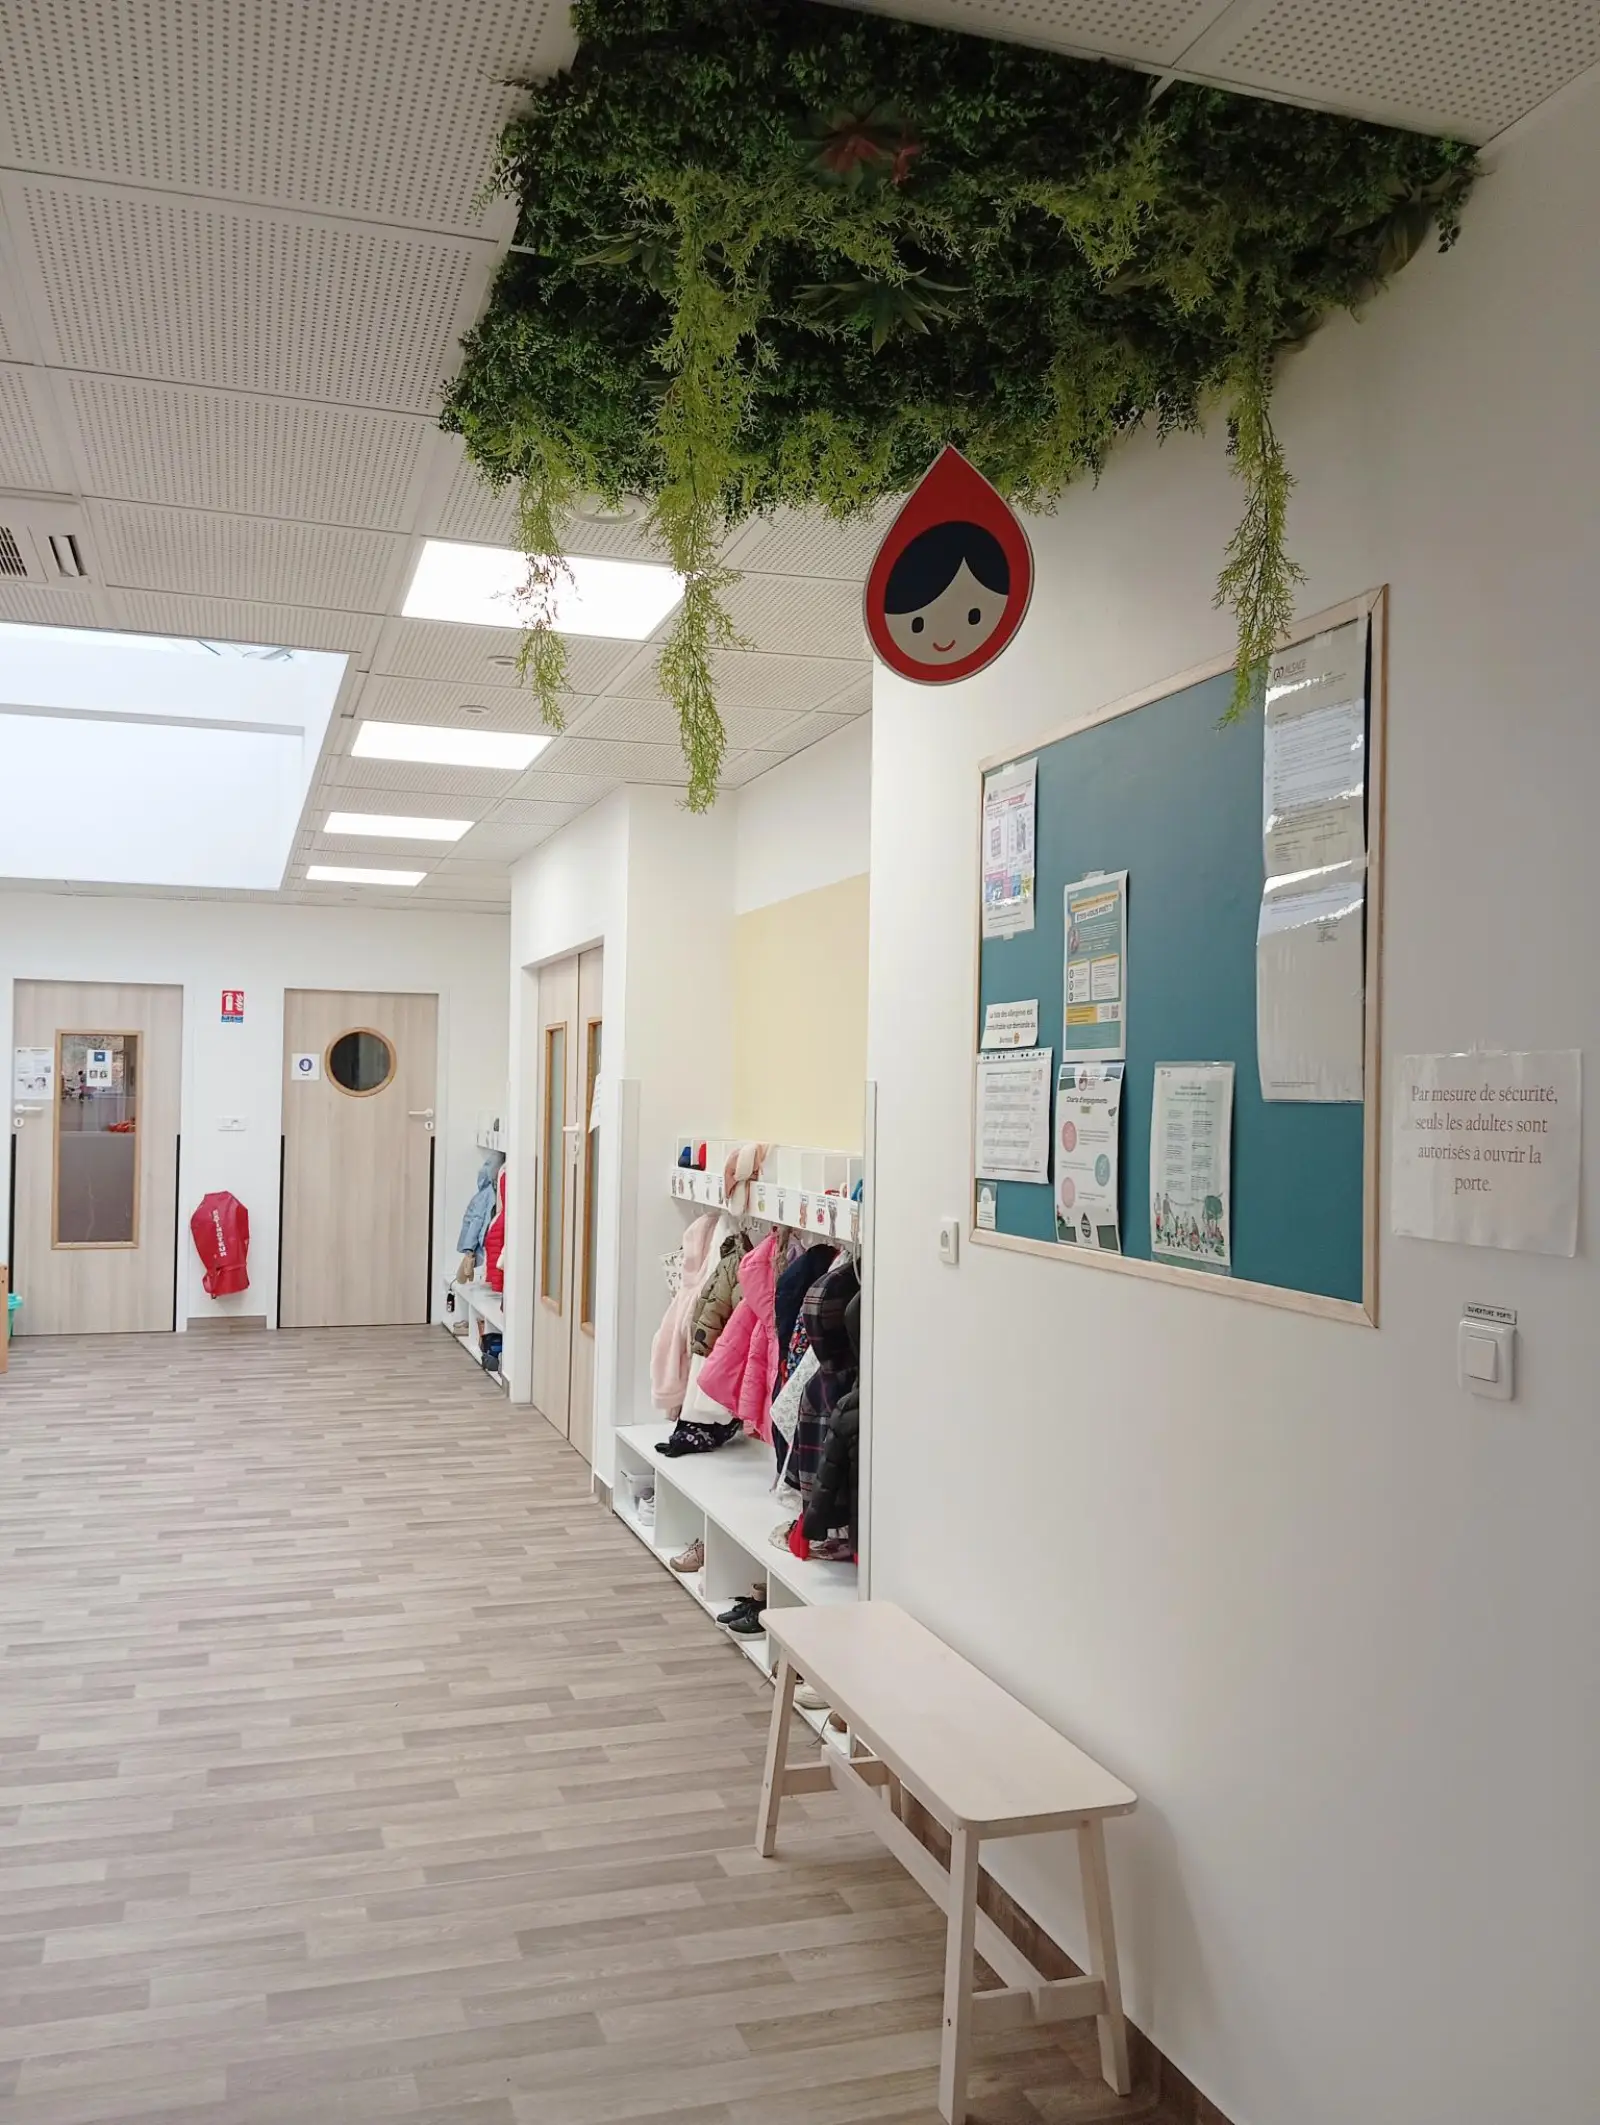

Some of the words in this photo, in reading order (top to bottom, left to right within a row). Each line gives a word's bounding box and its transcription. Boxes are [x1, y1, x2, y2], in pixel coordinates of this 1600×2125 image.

[1412, 1085, 1429, 1101] Par
[1432, 1088, 1477, 1101] mesure
[1480, 1083, 1496, 1102] de
[1499, 1085, 1558, 1104] sécurité,
[1415, 1112, 1443, 1131] seuls
[1446, 1112, 1463, 1131] les
[1466, 1113, 1513, 1132] adultes
[1516, 1119, 1548, 1133] sont
[1418, 1144, 1471, 1161] autorisés
[1473, 1147, 1480, 1161] à
[1484, 1146, 1526, 1164] ouvrir
[1529, 1145, 1542, 1164] la
[1454, 1176, 1492, 1195] porte.
